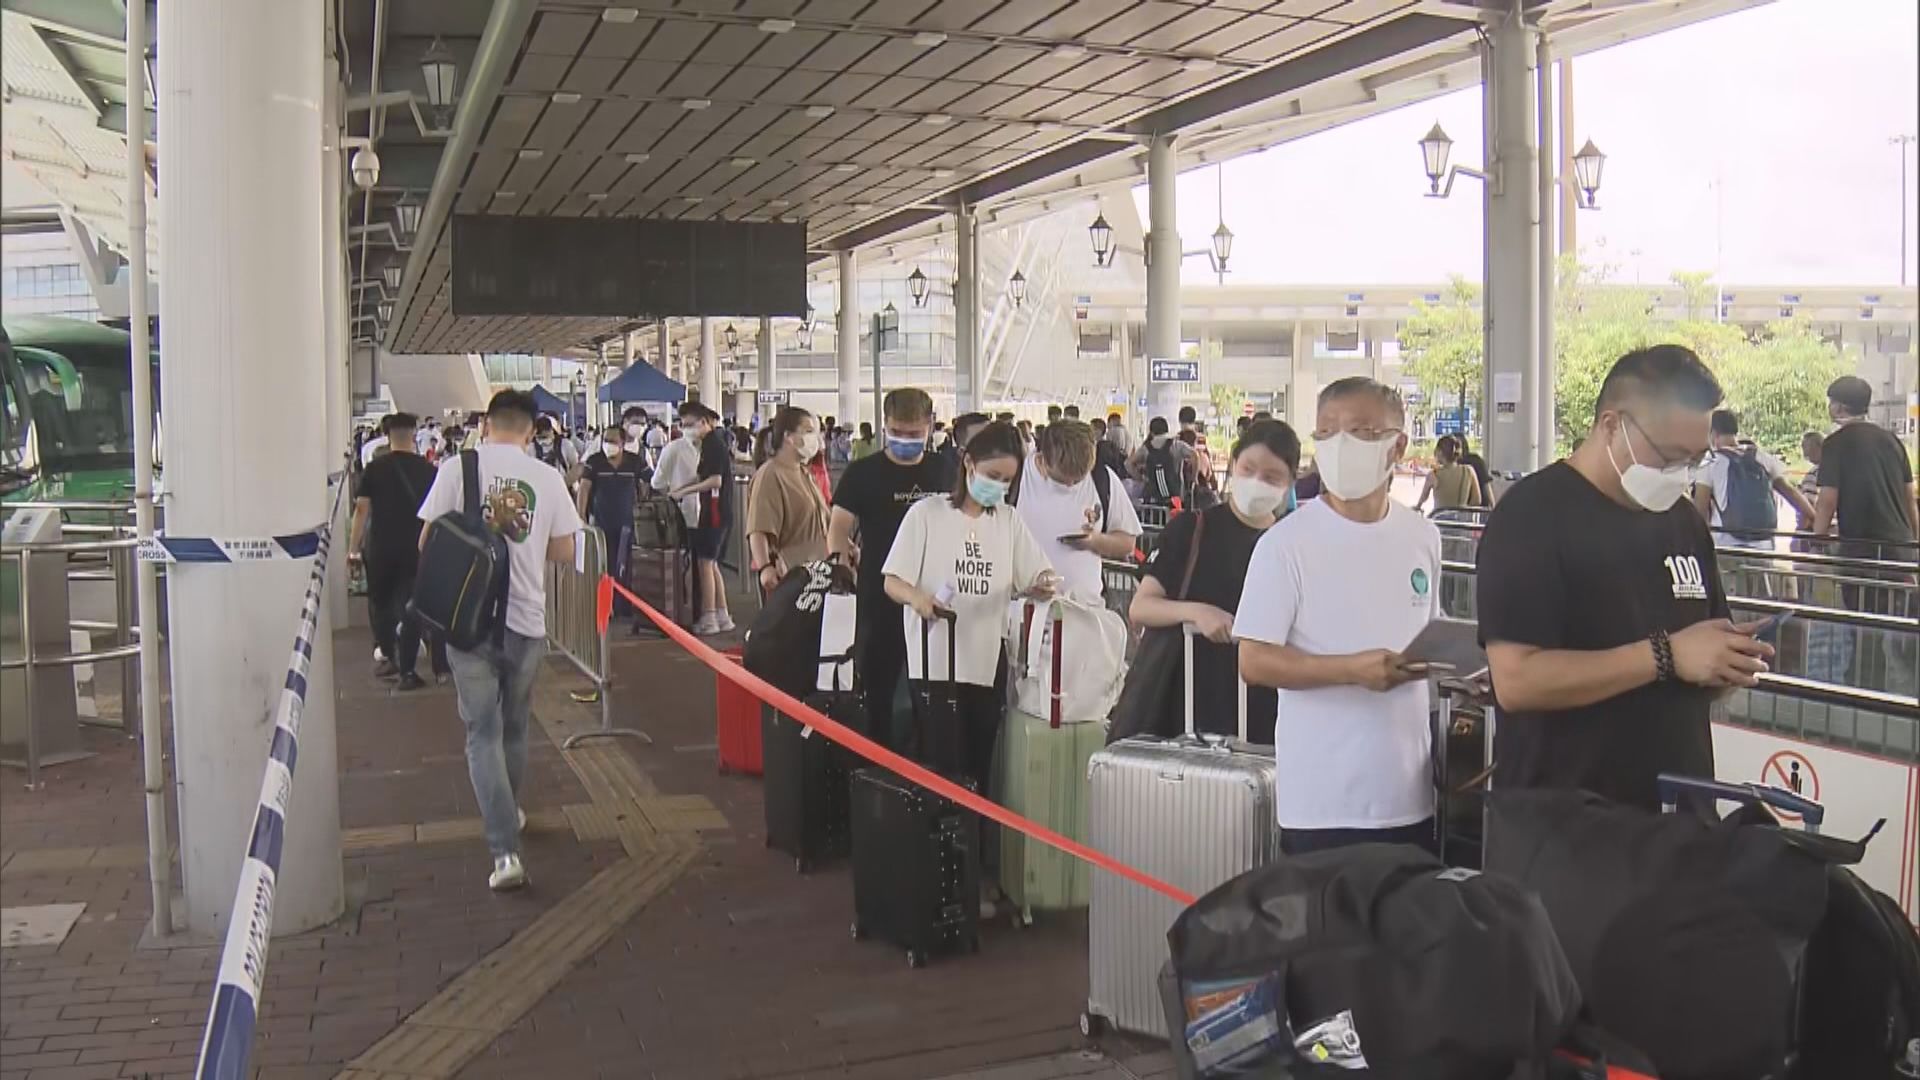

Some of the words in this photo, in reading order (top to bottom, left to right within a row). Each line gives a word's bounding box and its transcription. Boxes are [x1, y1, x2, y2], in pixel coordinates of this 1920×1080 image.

[964, 541, 982, 559] BE
[955, 558, 993, 577] MORE
[1664, 555, 1703, 586] 100
[957, 577, 989, 595] WILD
